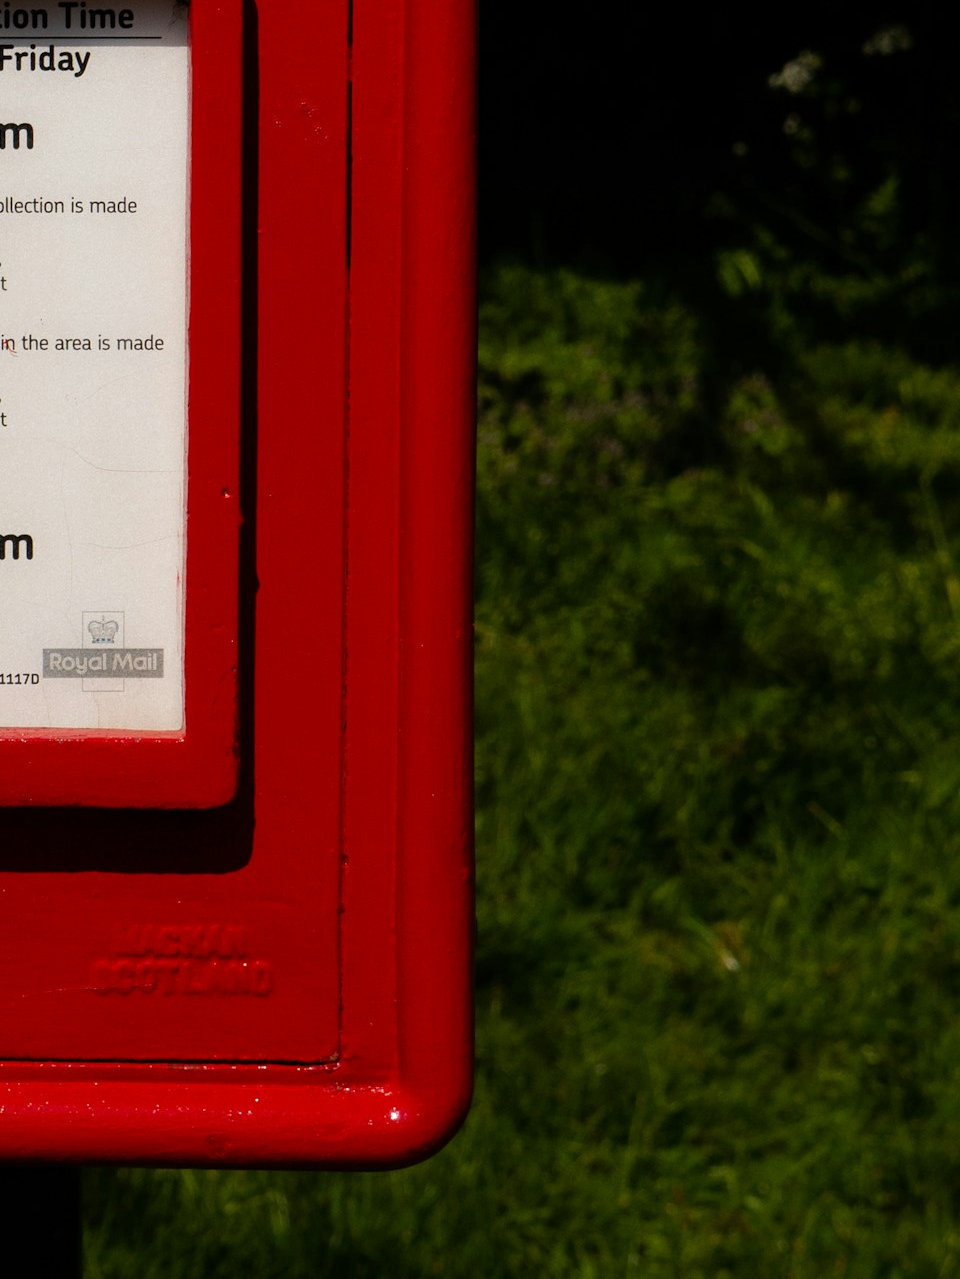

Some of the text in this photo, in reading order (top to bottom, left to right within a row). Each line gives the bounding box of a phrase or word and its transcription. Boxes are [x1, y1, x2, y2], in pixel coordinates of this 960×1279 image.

[57, 1, 136, 30] Time
[71, 196, 84, 214] is
[89, 196, 138, 214] made
[0, 334, 16, 352] in
[21, 334, 49, 351] the
[54, 338, 92, 351] area
[98, 334, 111, 351] is
[116, 334, 164, 351] made
[48, 652, 159, 675] Royal Mail
